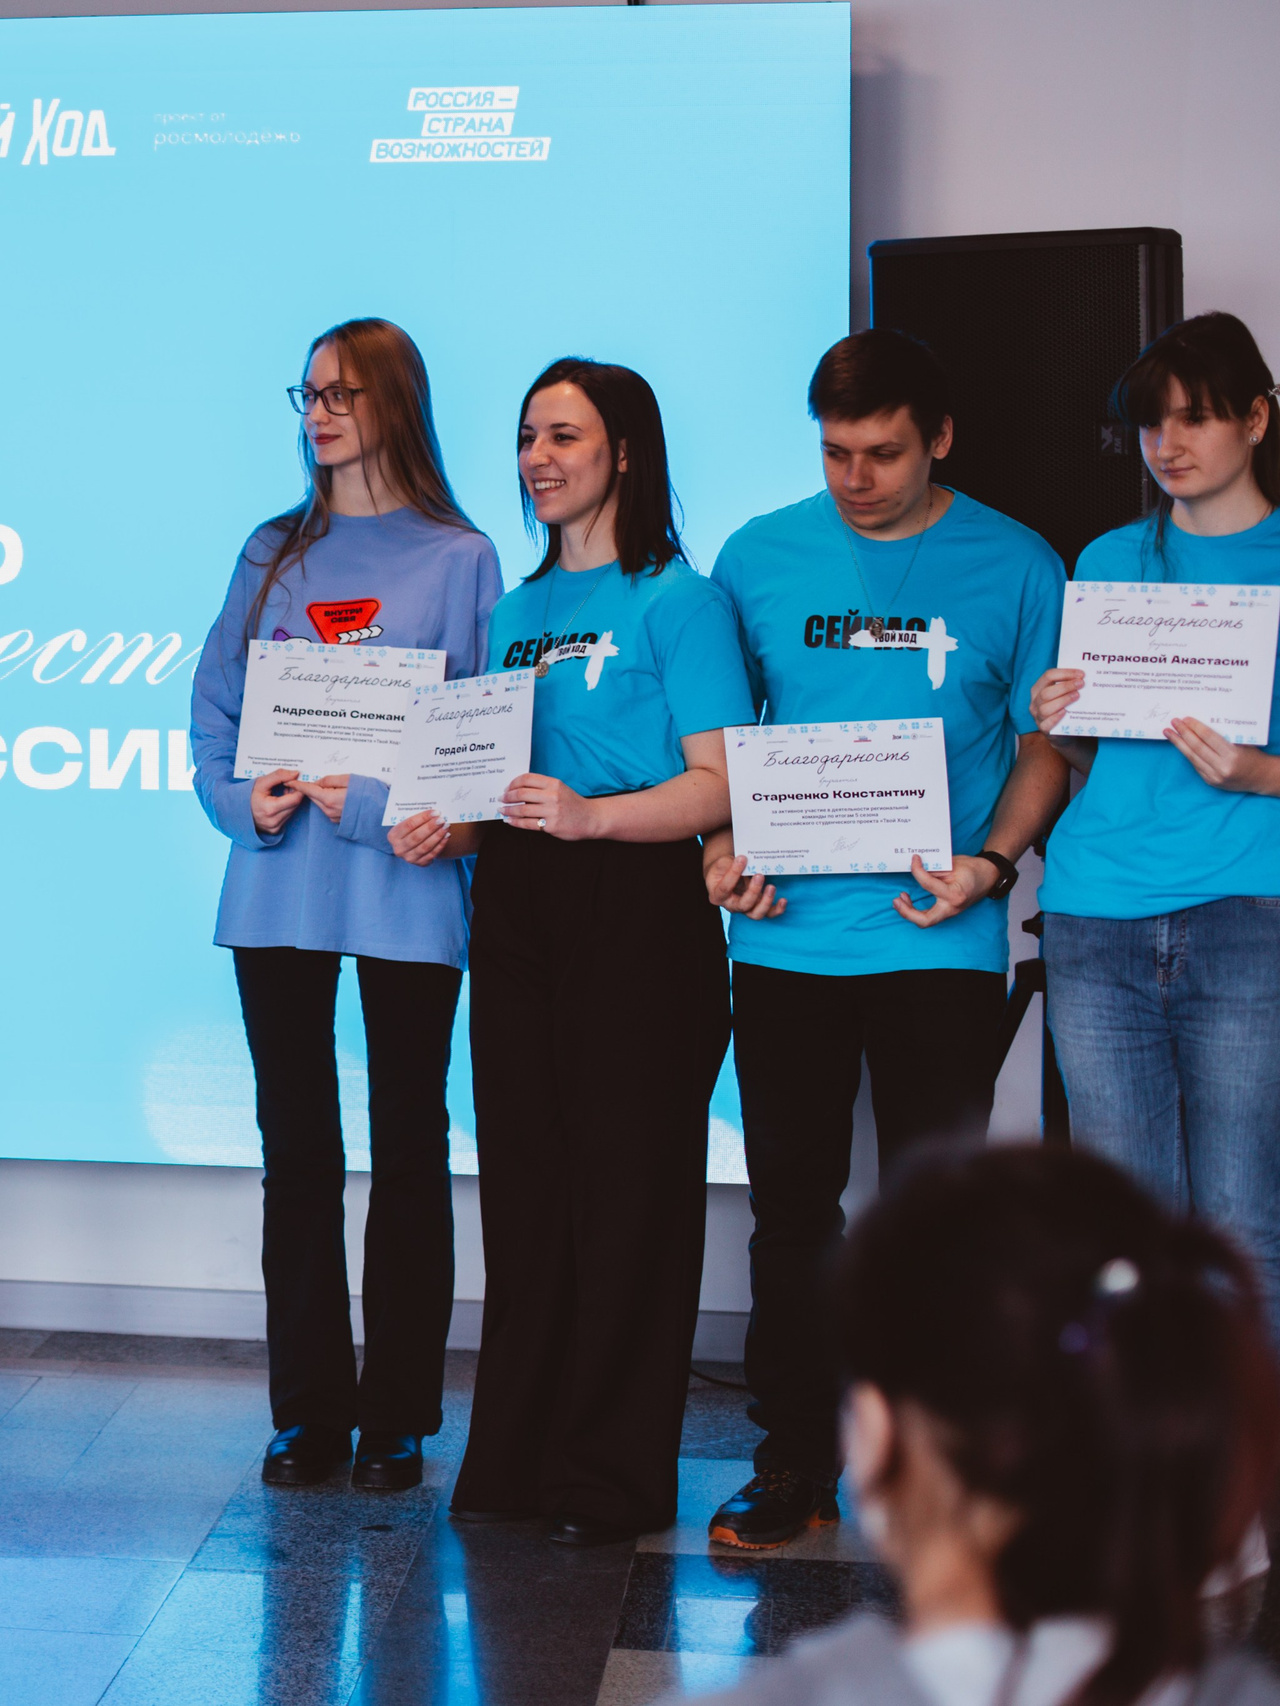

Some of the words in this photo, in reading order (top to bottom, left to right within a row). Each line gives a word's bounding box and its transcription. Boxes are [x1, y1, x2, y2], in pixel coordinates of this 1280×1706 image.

[413, 91, 495, 108] РОССИЯ
[427, 116, 505, 134] СТРАНА
[375, 139, 545, 159] ВОЗМОЖНОСТЕЙ
[324, 607, 363, 617] ВНУТРИ
[331, 615, 356, 623] СЕБЯ
[1097, 609, 1243, 637] Благодарность
[898, 633, 917, 644] ХОД
[572, 644, 587, 654] ХОД
[1082, 652, 1167, 664] Петраковой
[1171, 655, 1249, 666] Анастасии
[278, 666, 411, 693] Благодарность
[273, 705, 347, 718] Андреевой
[425, 703, 513, 729] Благодарность
[434, 744, 467, 757] Гордей
[469, 743, 495, 752] Ольге
[763, 750, 910, 775] Благодарность
[752, 792, 829, 803] Старченко
[833, 789, 925, 799] Константину
